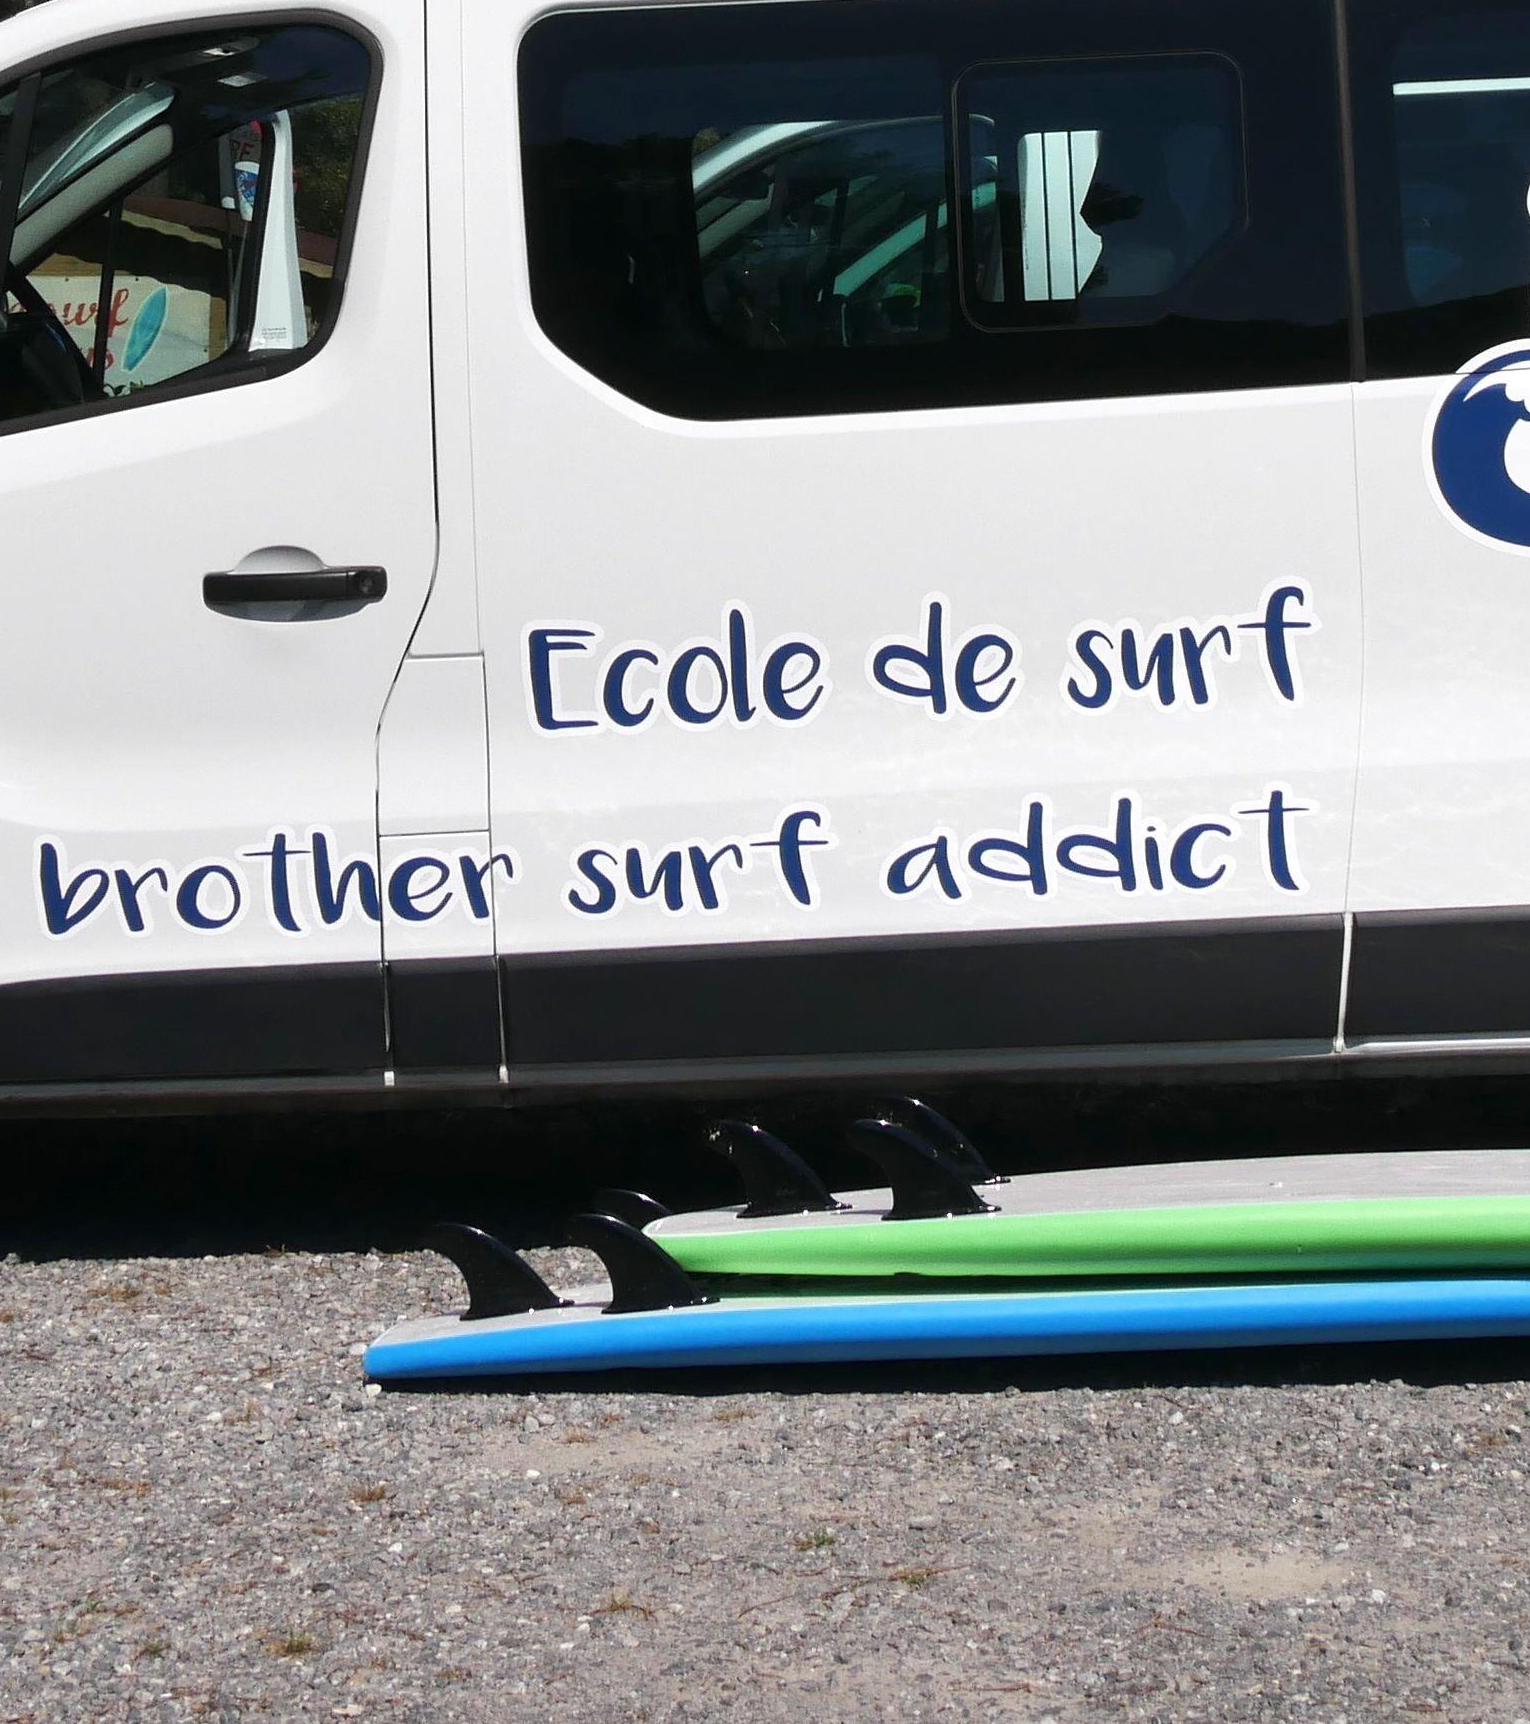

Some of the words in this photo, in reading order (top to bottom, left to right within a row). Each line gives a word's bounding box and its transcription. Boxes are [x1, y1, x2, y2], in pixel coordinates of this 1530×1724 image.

[529, 609, 824, 731] Ecole
[873, 601, 1018, 715] de
[1069, 584, 1313, 708] surf
[40, 832, 514, 934] brother
[568, 809, 831, 914] surf
[887, 789, 1310, 900] addict
